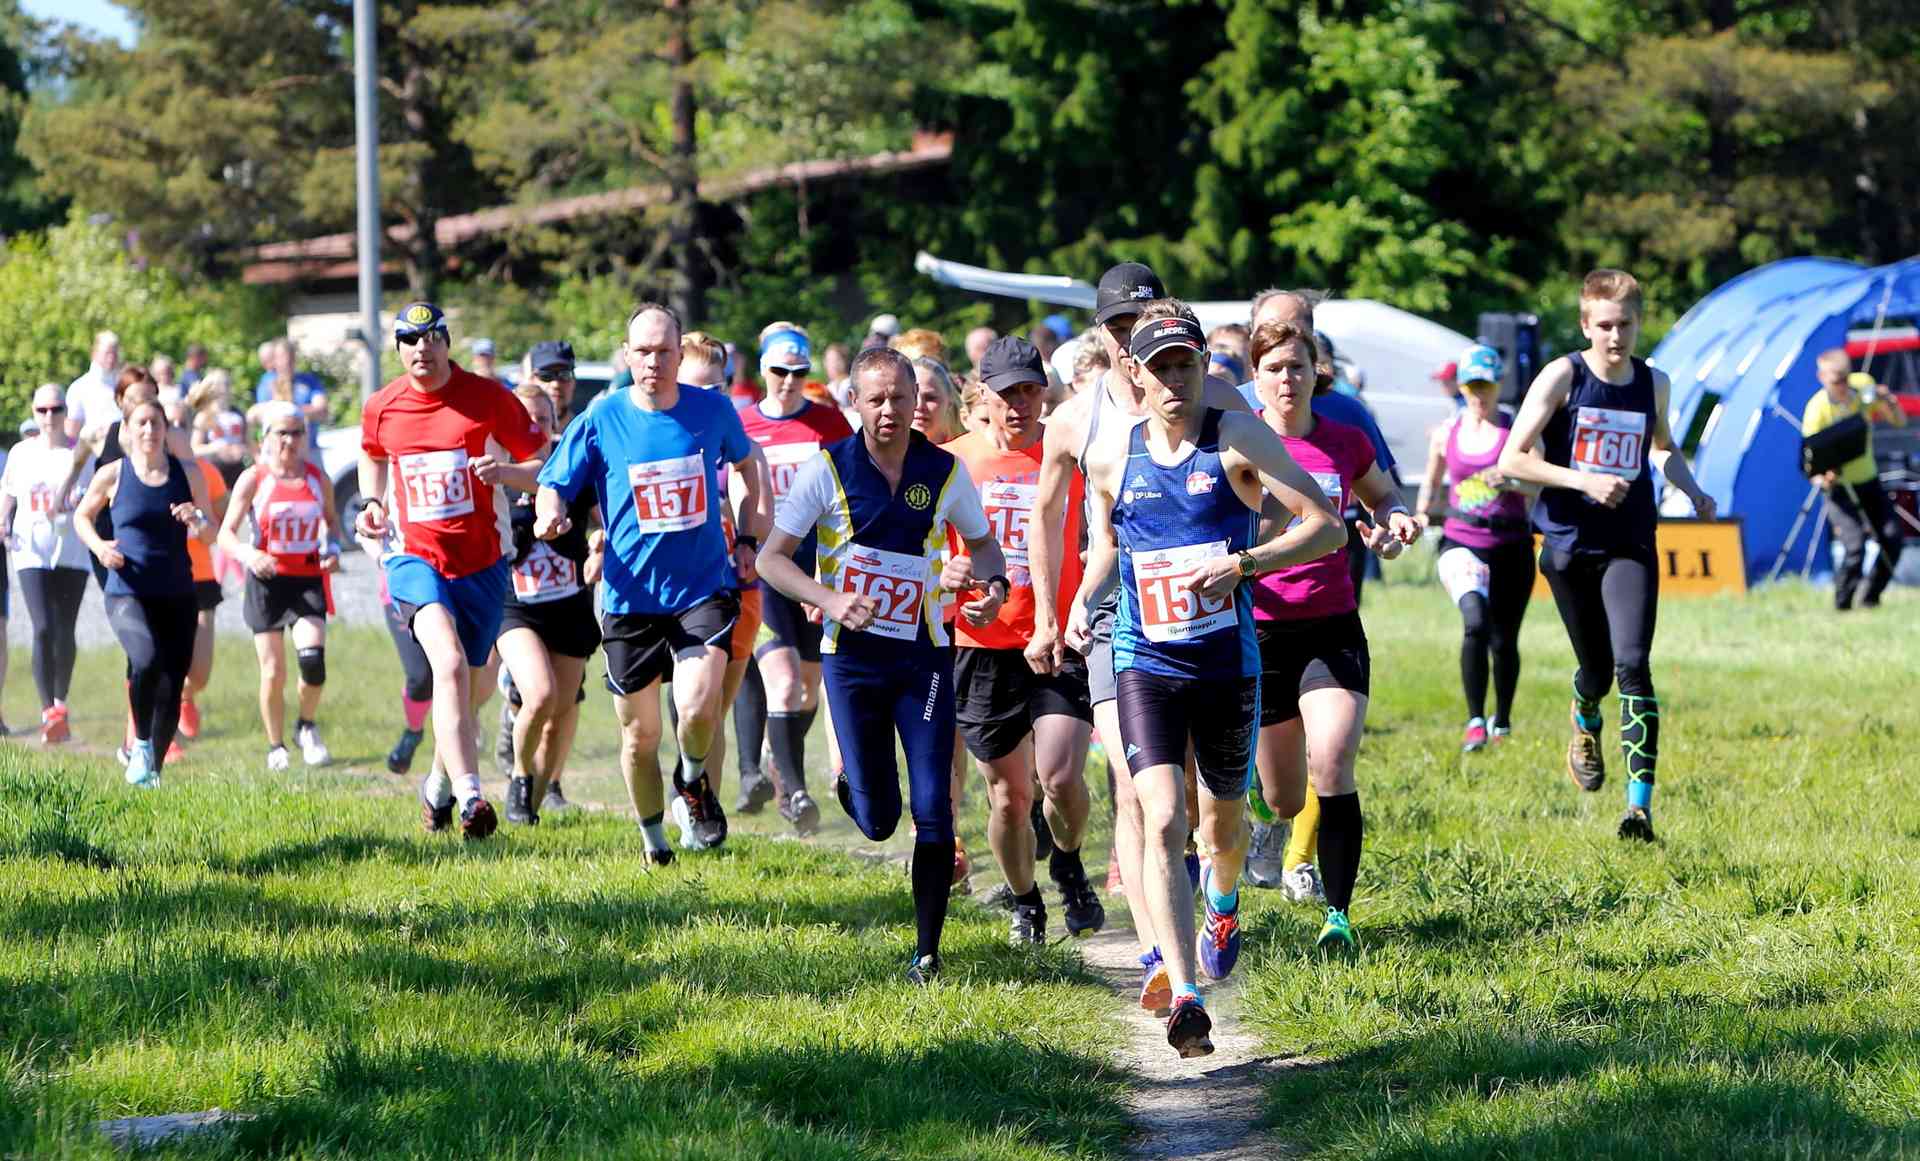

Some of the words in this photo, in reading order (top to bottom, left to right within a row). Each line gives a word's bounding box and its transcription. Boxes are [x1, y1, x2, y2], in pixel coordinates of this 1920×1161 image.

[1582, 430, 1637, 468] 160
[408, 471, 466, 507] 158
[640, 478, 699, 519] 157
[275, 513, 318, 543] 117
[987, 508, 1031, 551] 15
[518, 556, 573, 593] 123
[849, 573, 918, 623] 162
[923, 671, 940, 722] noname
